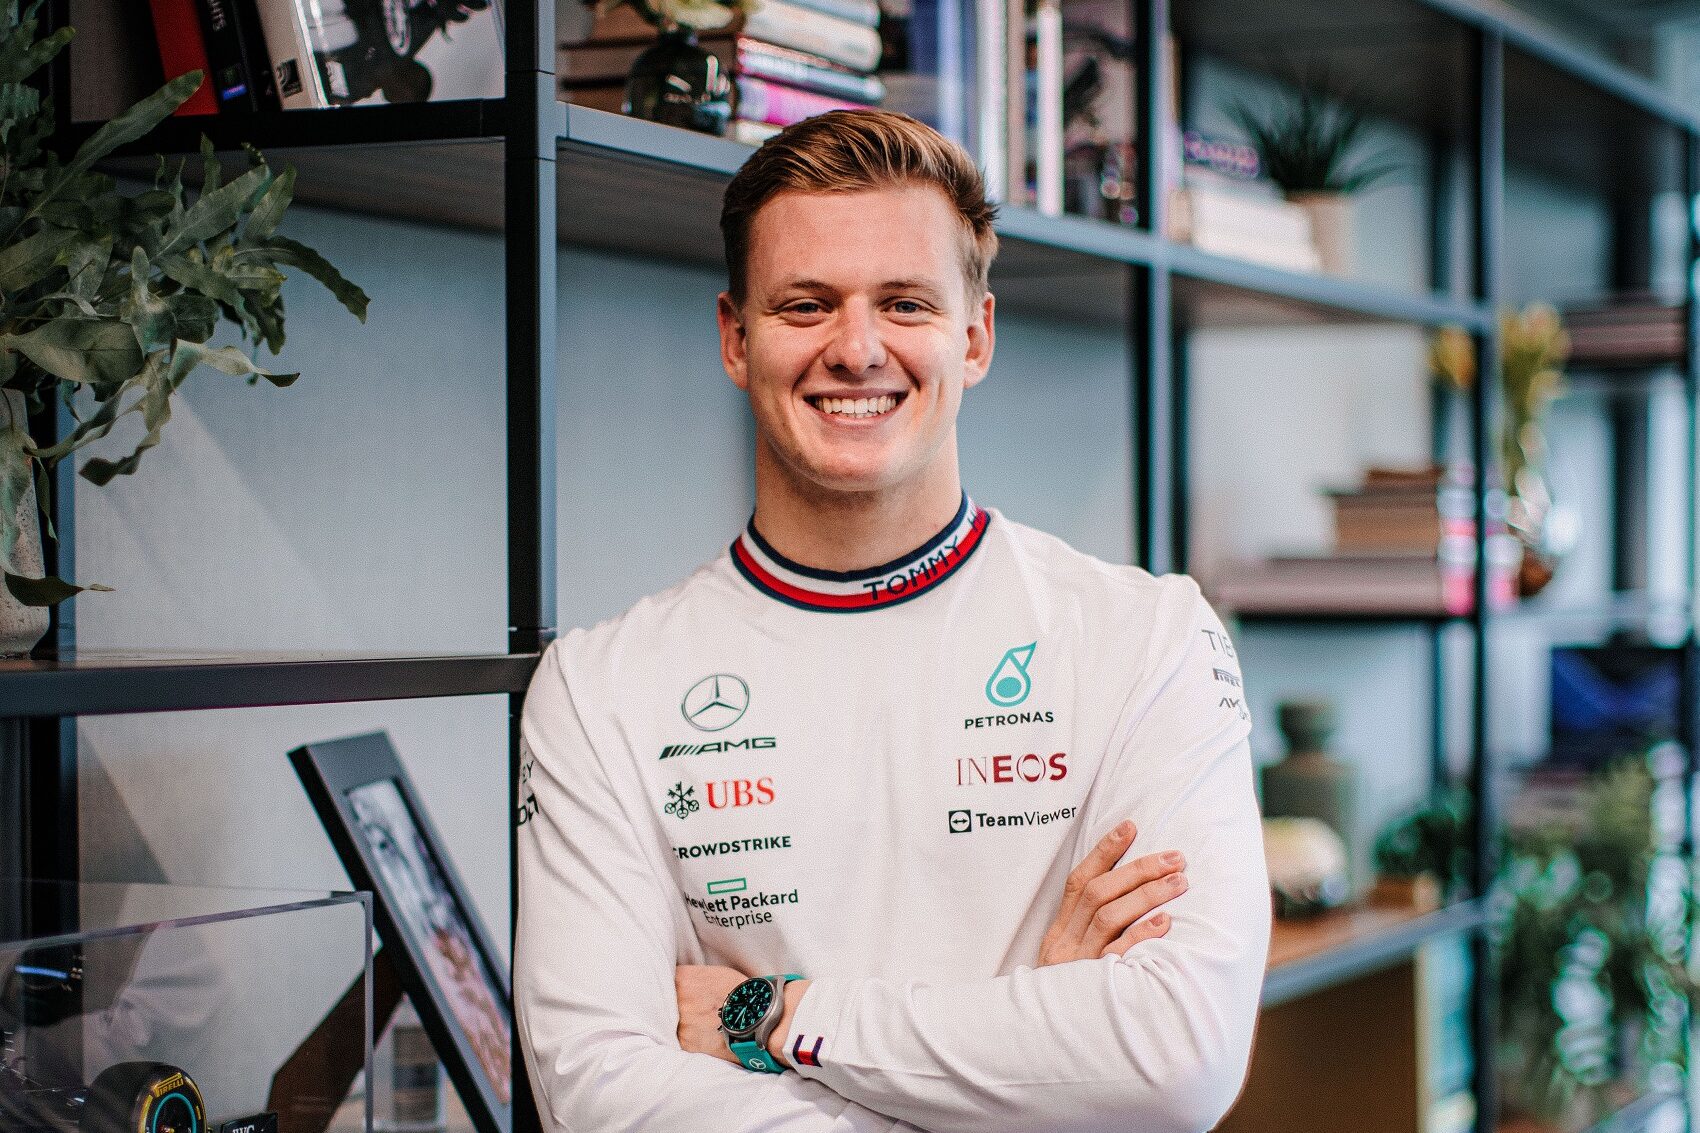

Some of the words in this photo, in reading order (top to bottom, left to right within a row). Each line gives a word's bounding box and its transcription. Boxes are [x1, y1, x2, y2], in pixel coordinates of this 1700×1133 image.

[863, 535, 960, 600] TOMMY
[964, 711, 1054, 729] PETRONAS
[696, 736, 776, 755] AMG
[956, 752, 1067, 786] INEOS
[704, 776, 776, 811] UBS
[976, 806, 1077, 828] TeamViewer
[673, 836, 792, 859] ROWDSTRIKE
[731, 889, 799, 911] Packard
